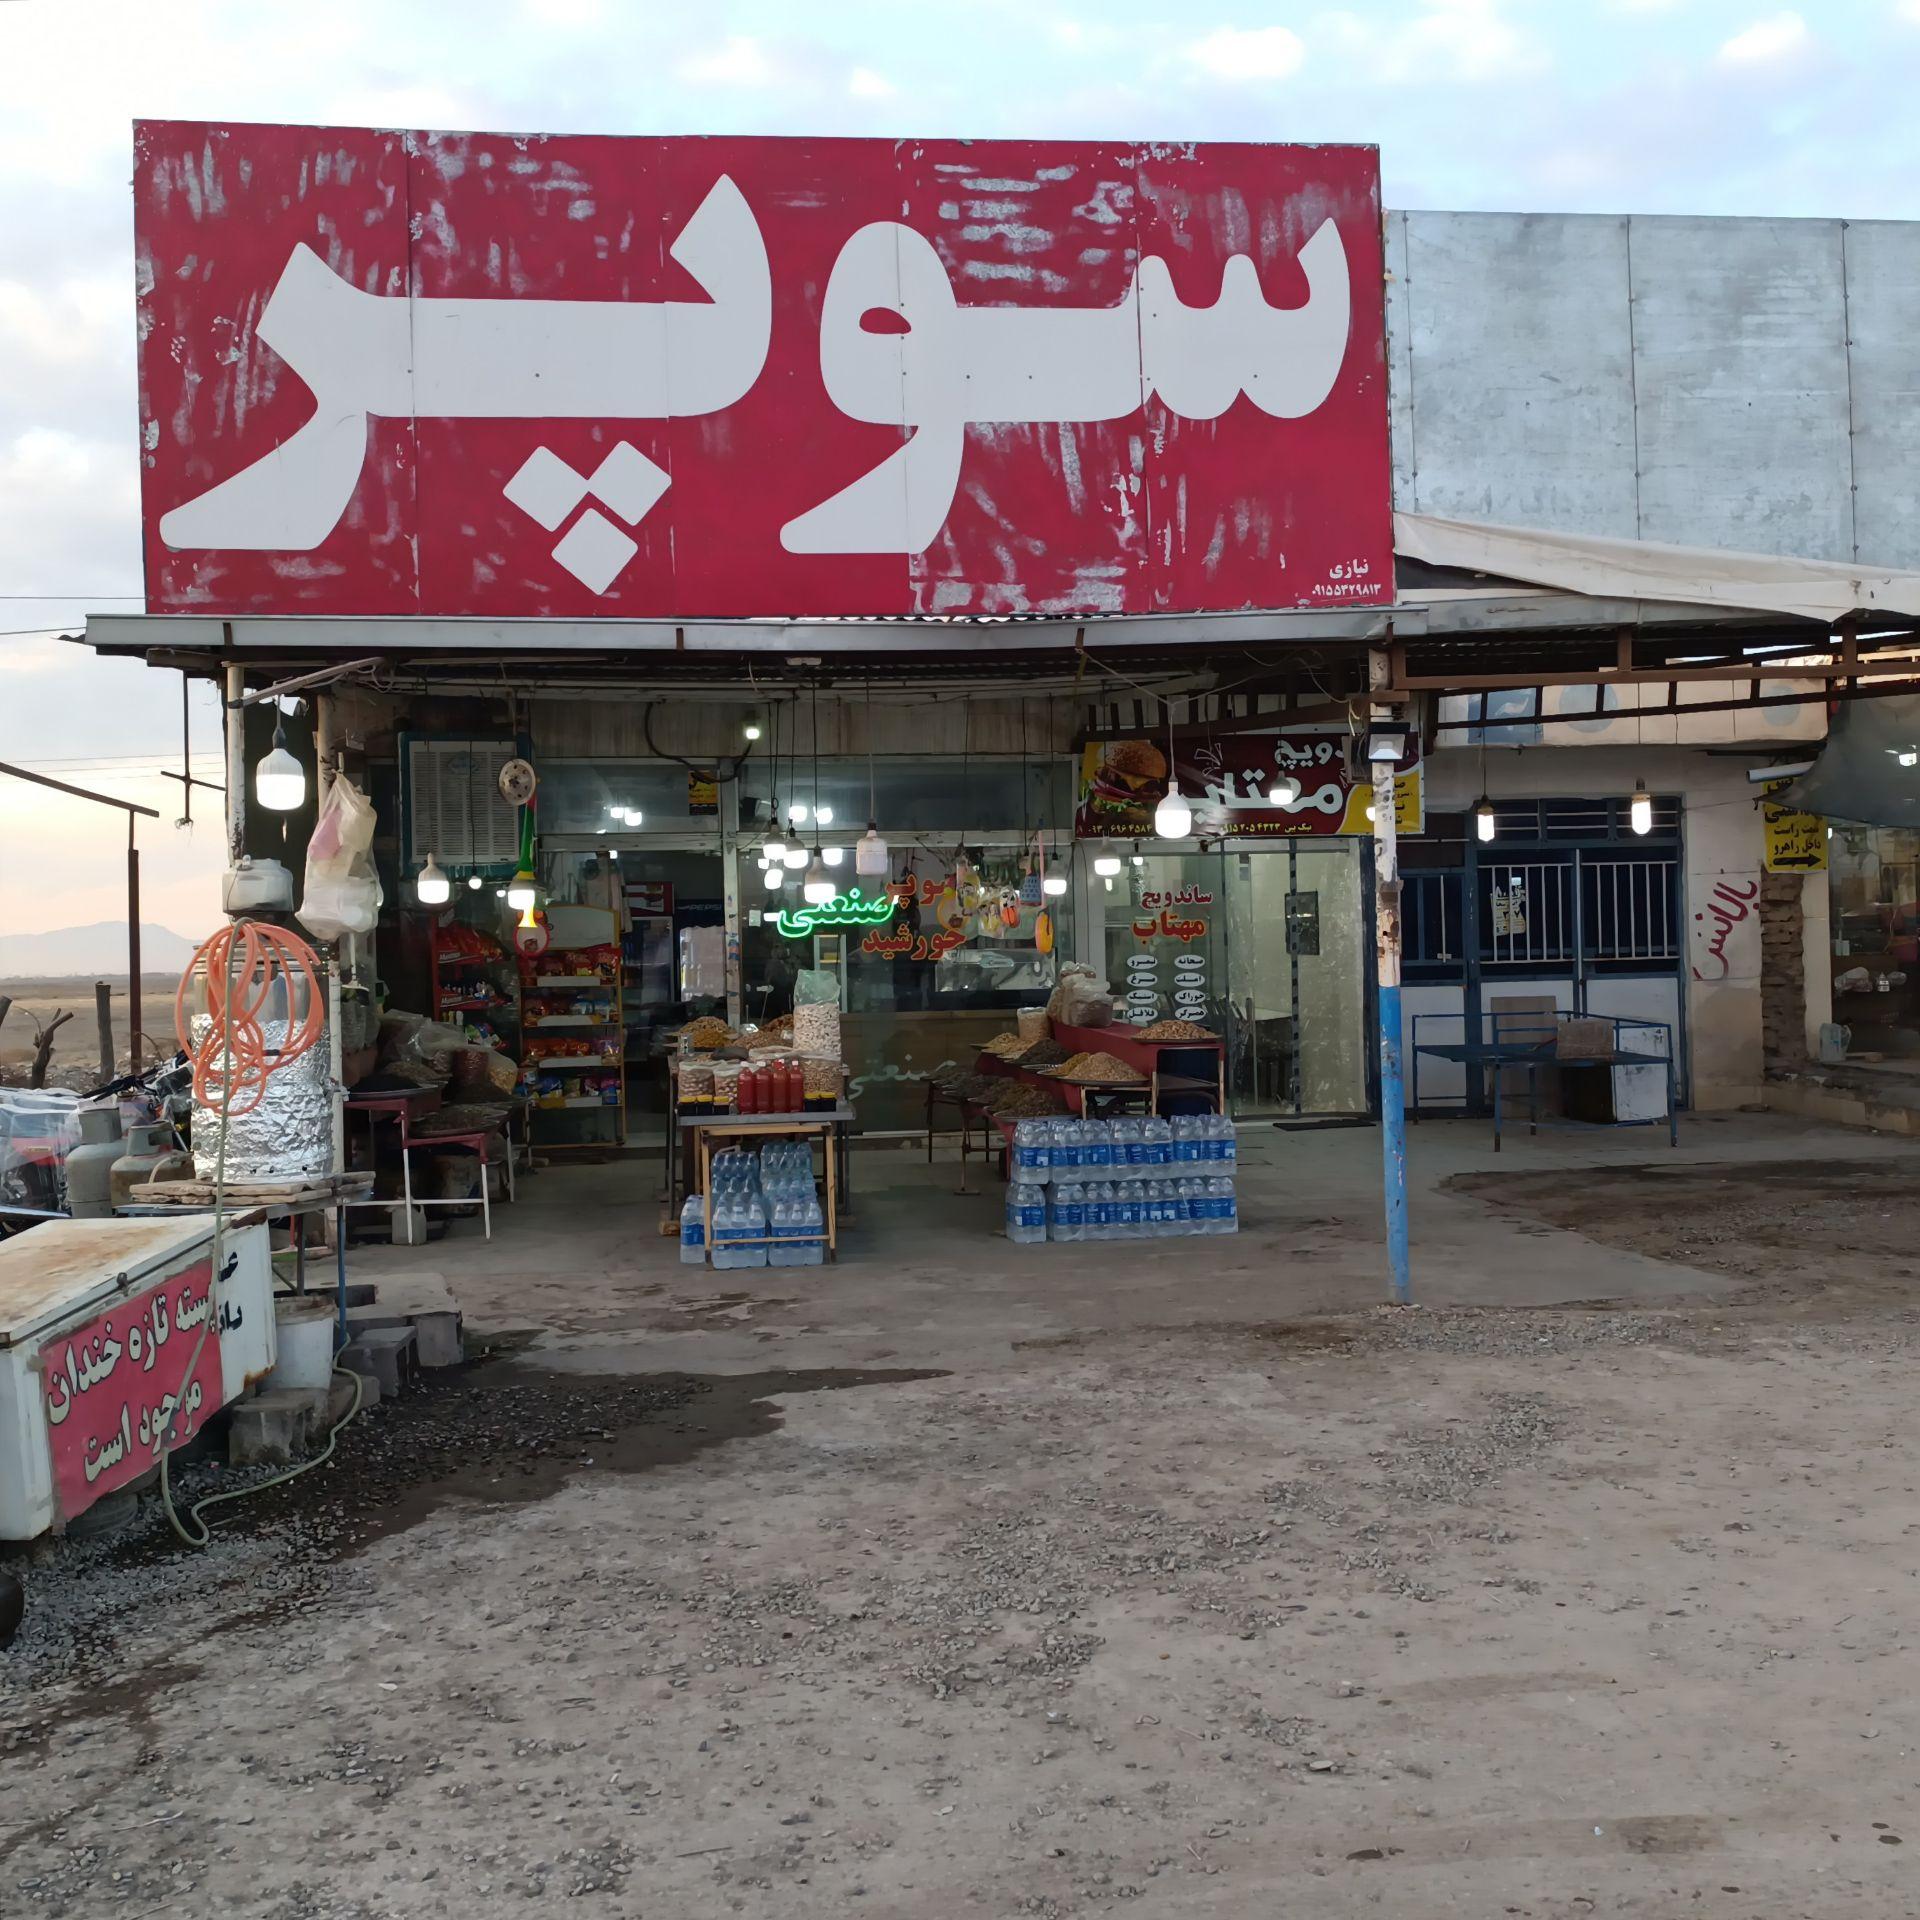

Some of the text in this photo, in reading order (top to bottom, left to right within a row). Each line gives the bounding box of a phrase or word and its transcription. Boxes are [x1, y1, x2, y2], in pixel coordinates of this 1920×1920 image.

[159, 173, 1351, 597] سوپر
[1329, 558, 1369, 579] نیازی
[1774, 823, 1800, 837] راست
[1774, 838, 1821, 855] داخل راهرو
[1141, 885, 1213, 909] ساندویچ
[1132, 911, 1206, 945] مهتاب
[1692, 880, 1760, 981] بالانس
[129, 1293, 170, 1373] تازه
[48, 1321, 122, 1425] خندان
[84, 1380, 203, 1482] موجود است
